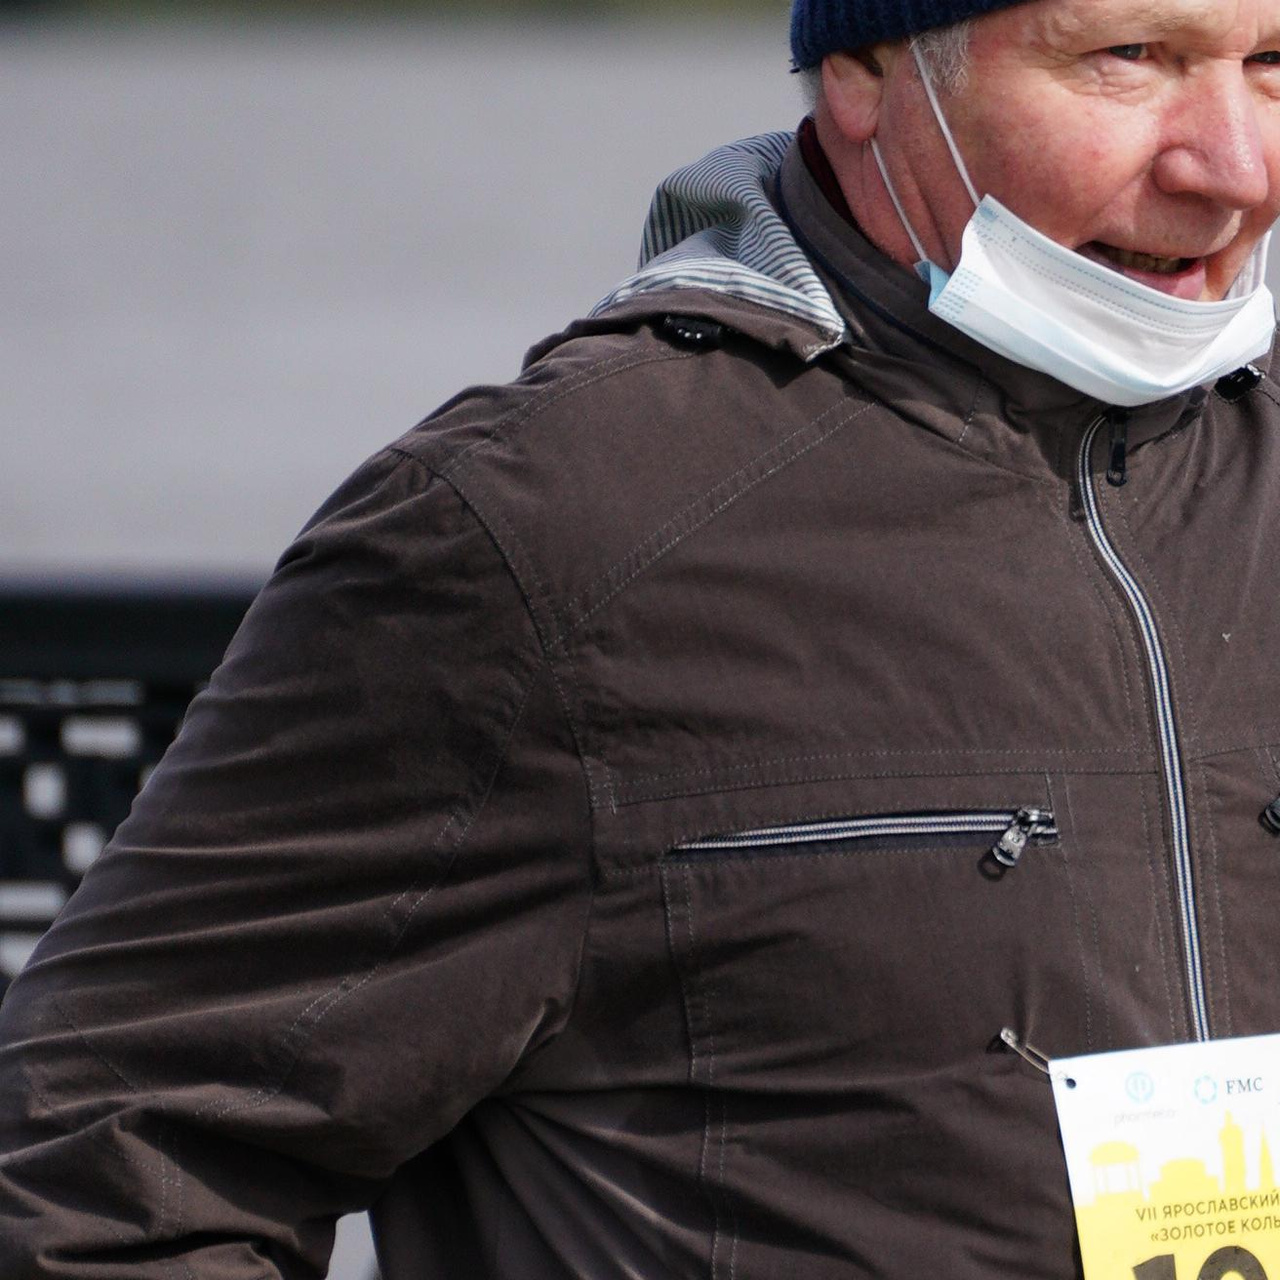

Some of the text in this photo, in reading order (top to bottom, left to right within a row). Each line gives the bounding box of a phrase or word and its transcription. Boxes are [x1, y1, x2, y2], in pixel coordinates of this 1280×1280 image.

[1136, 1207, 1157, 1221] VII
[1163, 1189, 1280, 1218] ЯРОСЛАВСКИЙ
[1151, 1221, 1236, 1242] «ЗОЛОТОЕ
